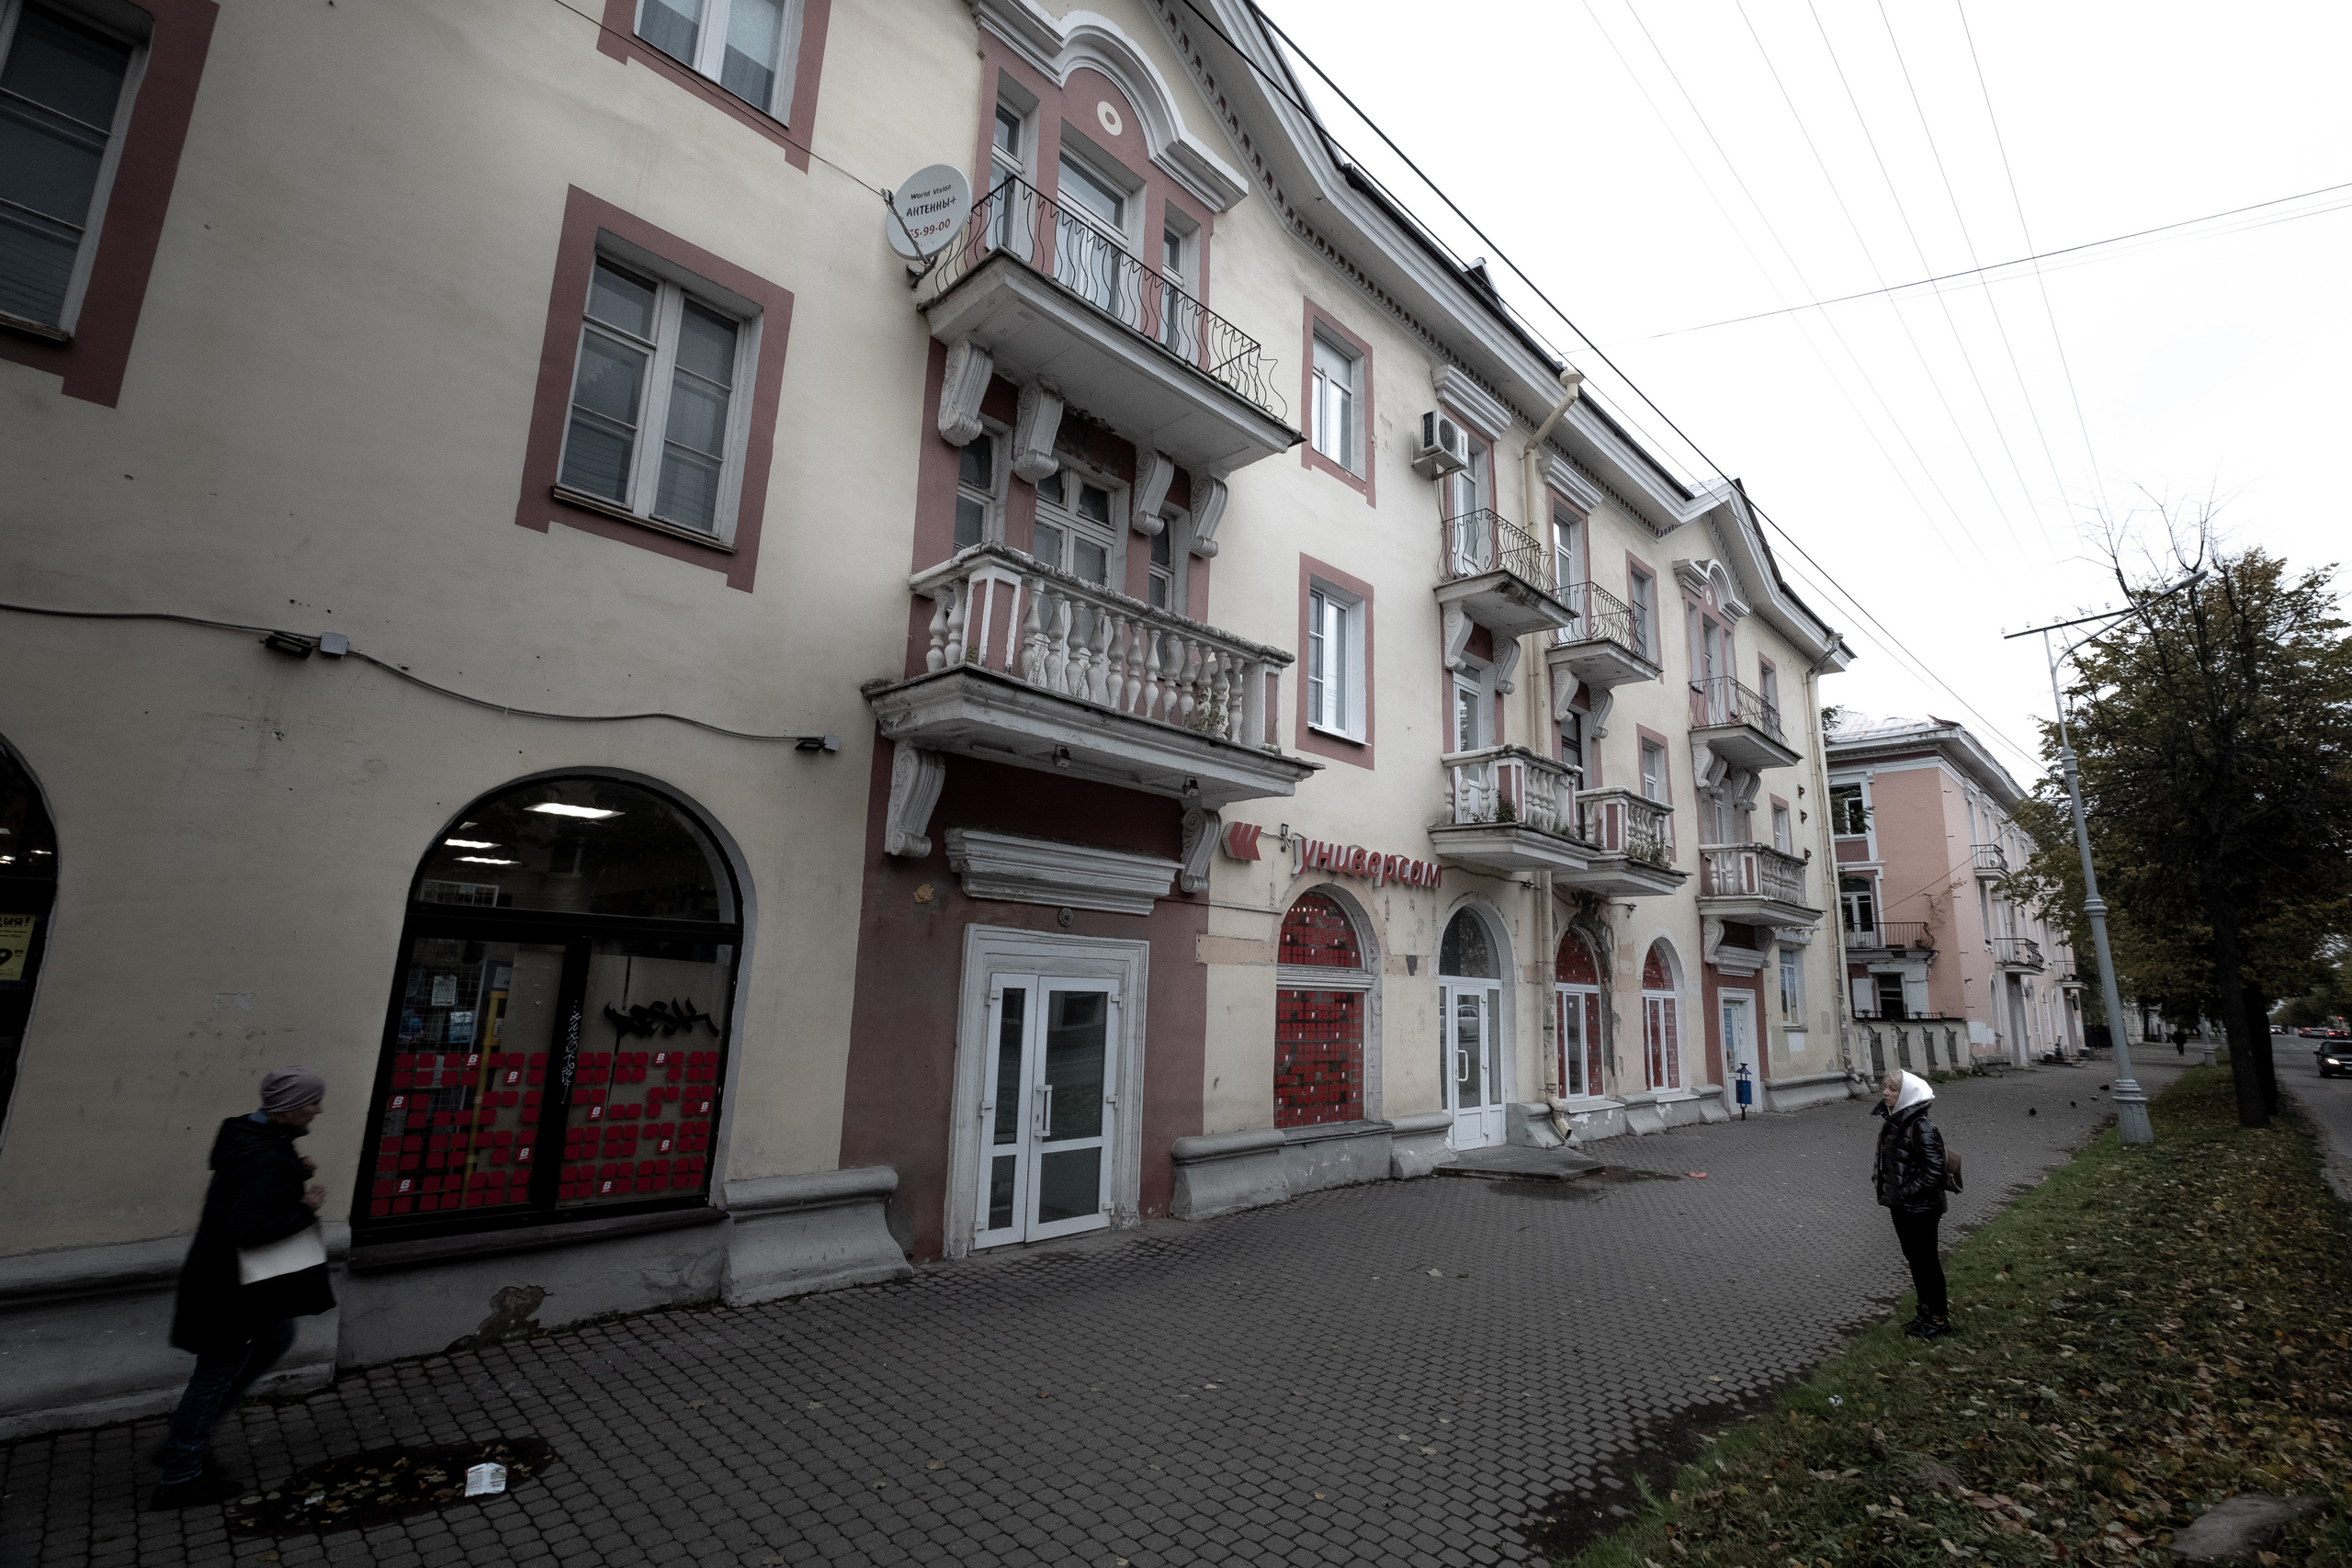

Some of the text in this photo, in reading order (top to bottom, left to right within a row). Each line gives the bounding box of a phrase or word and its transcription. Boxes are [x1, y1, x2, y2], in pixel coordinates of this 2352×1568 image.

[910, 184, 952, 199] World Vision
[1298, 838, 1442, 888] универсам
